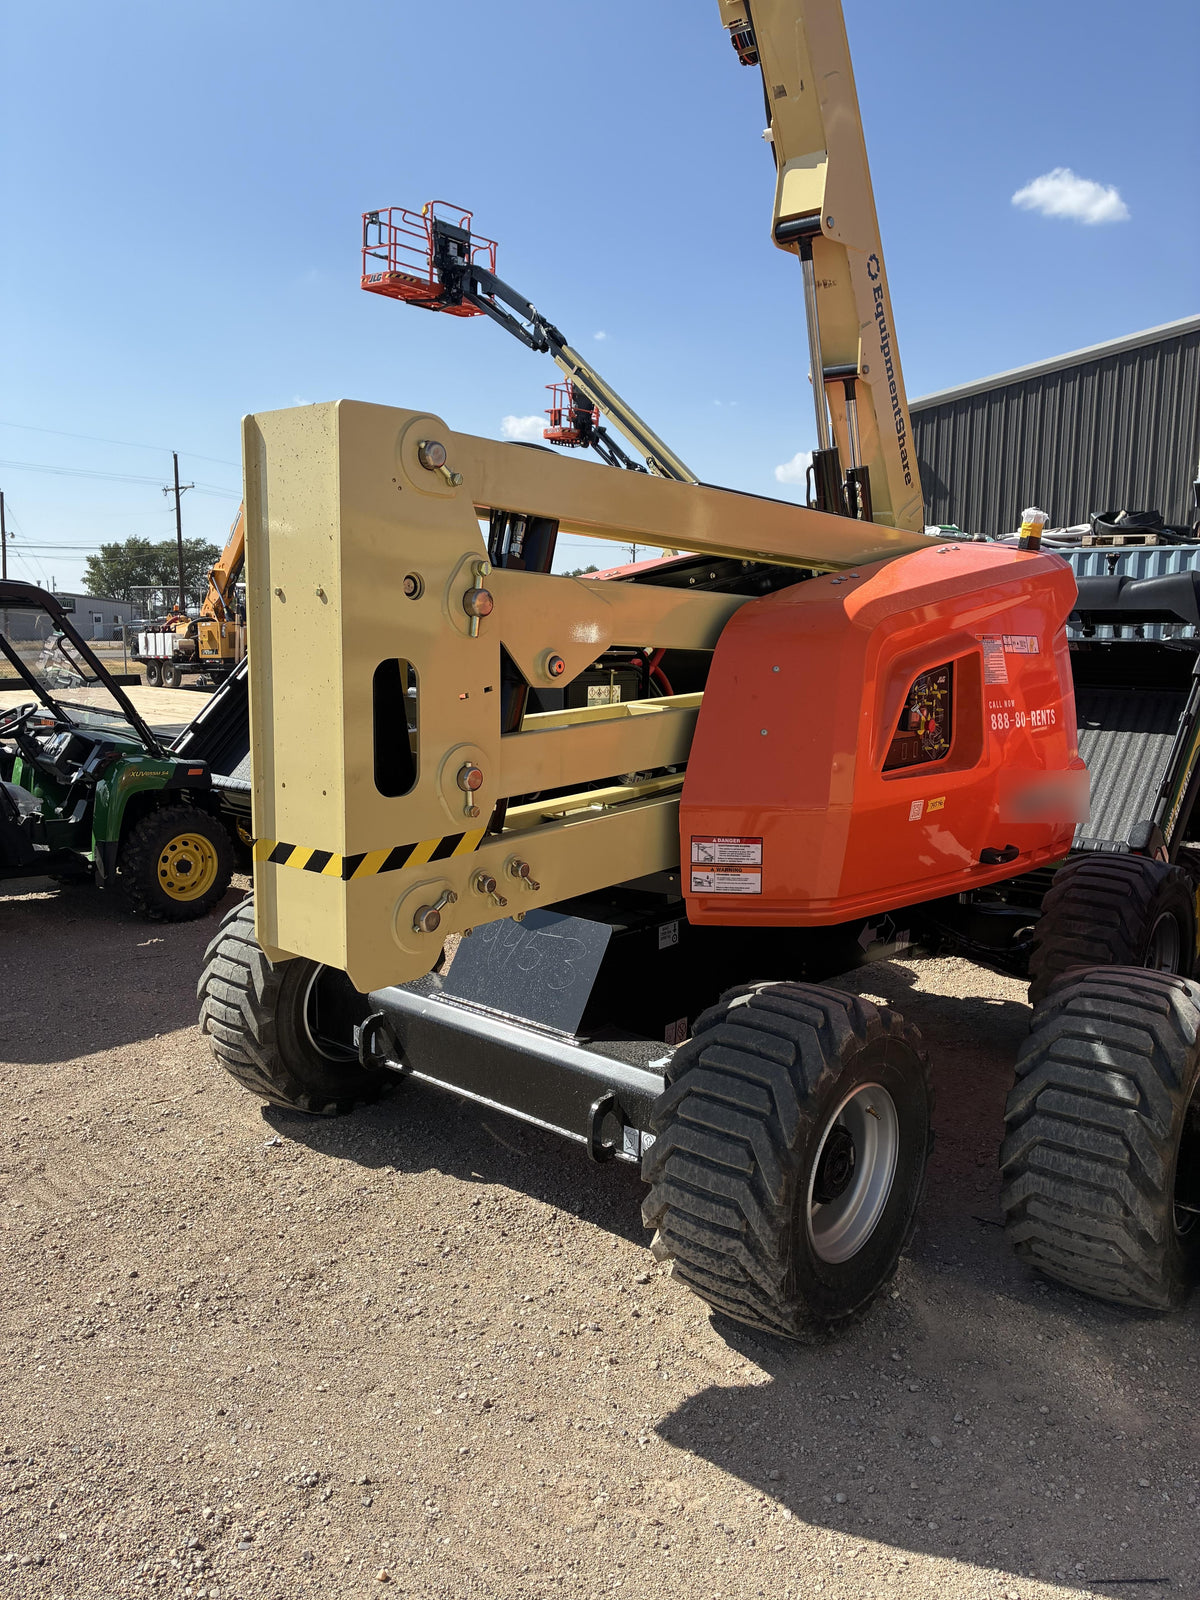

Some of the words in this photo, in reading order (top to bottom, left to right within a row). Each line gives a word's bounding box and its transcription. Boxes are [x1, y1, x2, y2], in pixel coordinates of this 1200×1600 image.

[368, 273, 383, 284] JLG
[872, 285, 911, 486] EquipmentShare
[988, 700, 1002, 709] CALL
[1004, 699, 1015, 708] NOW
[990, 709, 1056, 730] 888-80-RENTS
